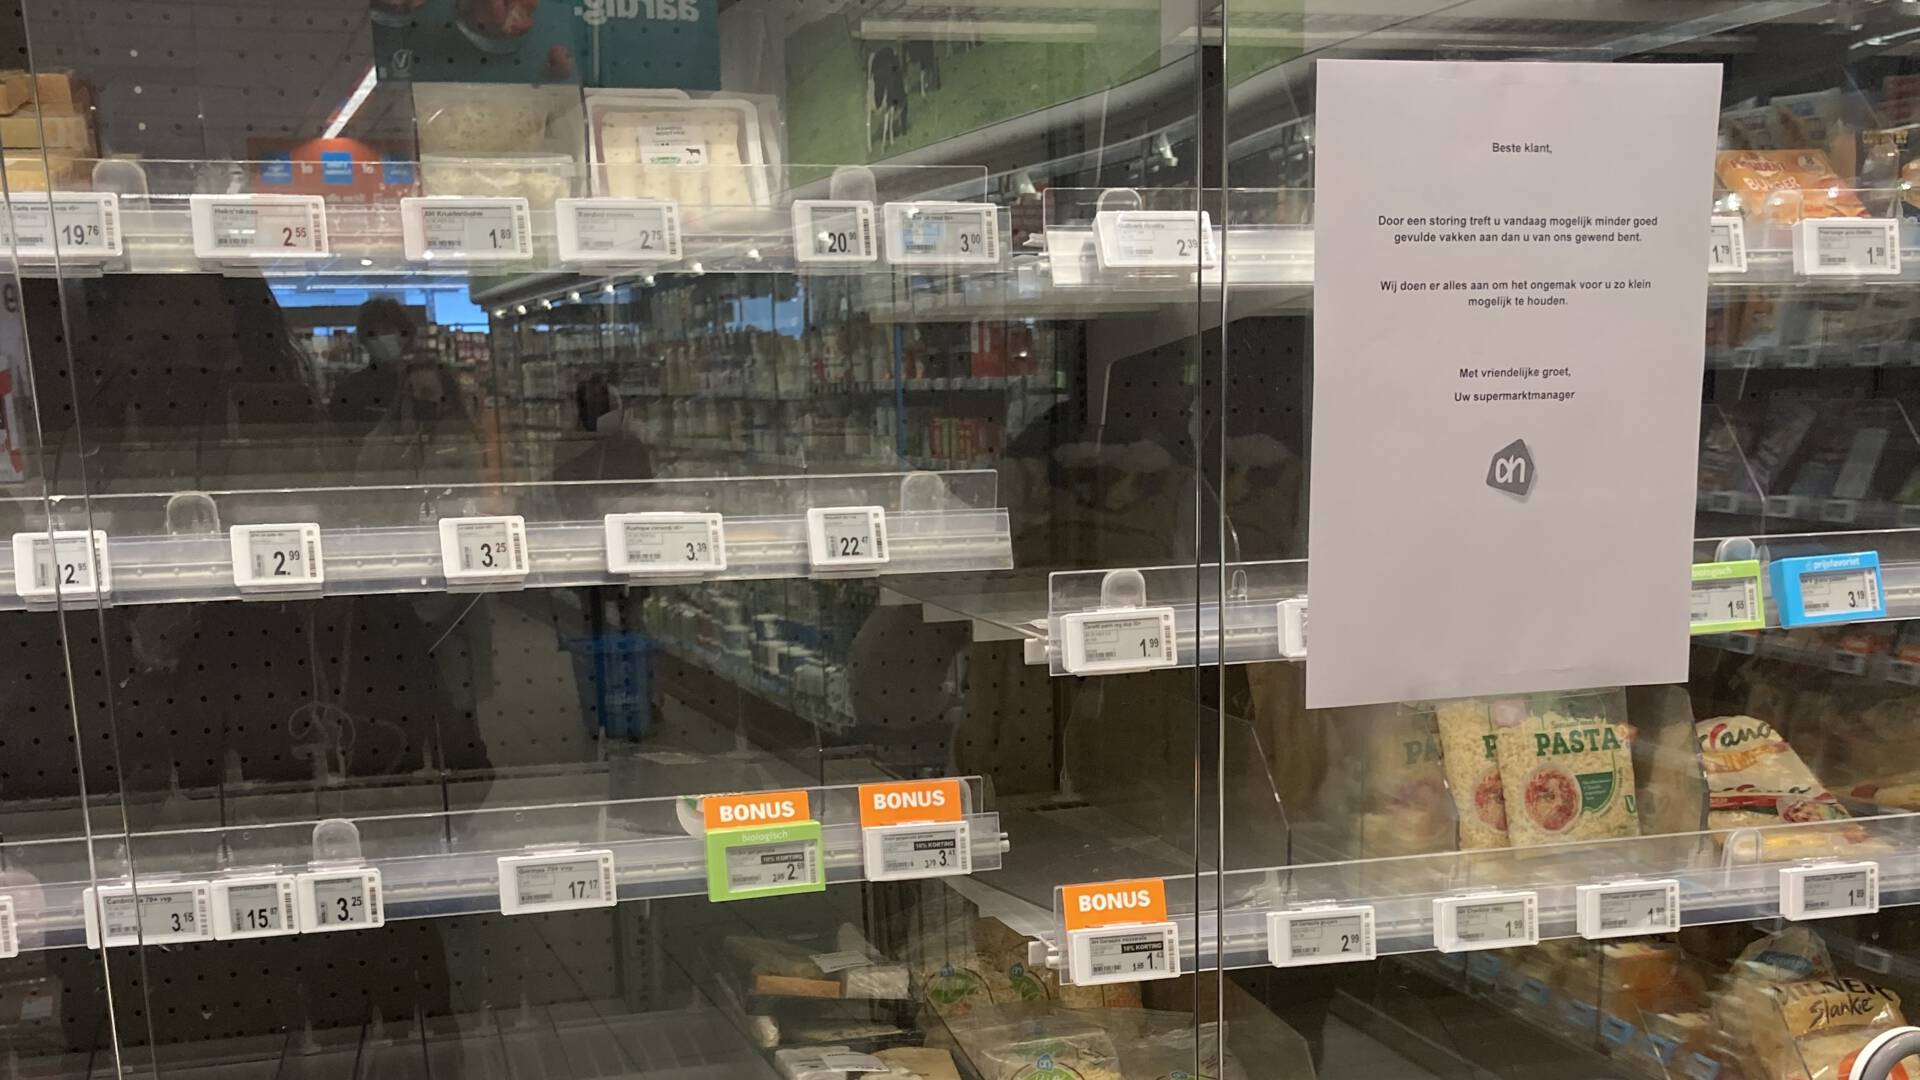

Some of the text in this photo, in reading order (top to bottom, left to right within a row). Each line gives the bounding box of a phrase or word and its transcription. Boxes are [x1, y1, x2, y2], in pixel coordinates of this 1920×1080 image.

[1492, 143, 1553, 154] Beste klant,
[1378, 215, 1658, 229] Door een storing treft u vandaag mogelijk minder goed
[1393, 231, 1643, 245] gevulde vakken aan dan u van ons gewend bent.
[1379, 278, 1652, 294] Wij doen er alles aan om het ongemak voor u zo klein
[1467, 295, 1569, 309] mogelijk te houden.
[1459, 366, 1572, 381] Met vriendelijke groet,
[1454, 390, 1576, 404] Uw supermarktmanager
[481, 542, 508, 568] 3.25
[686, 542, 708, 562] 3.39
[273, 550, 300, 576] 2.99
[1139, 637, 1160, 657] 1.99
[1534, 727, 1620, 757] PASTA
[873, 789, 945, 810] BONUS
[719, 800, 796, 823] BONUS
[741, 830, 789, 845] biologisch
[569, 879, 598, 900] 17.17
[336, 896, 363, 922] 3.25
[1078, 889, 1151, 913] BONUS
[171, 912, 194, 933] 3.15
[1808, 990, 1874, 1029] Slankie
